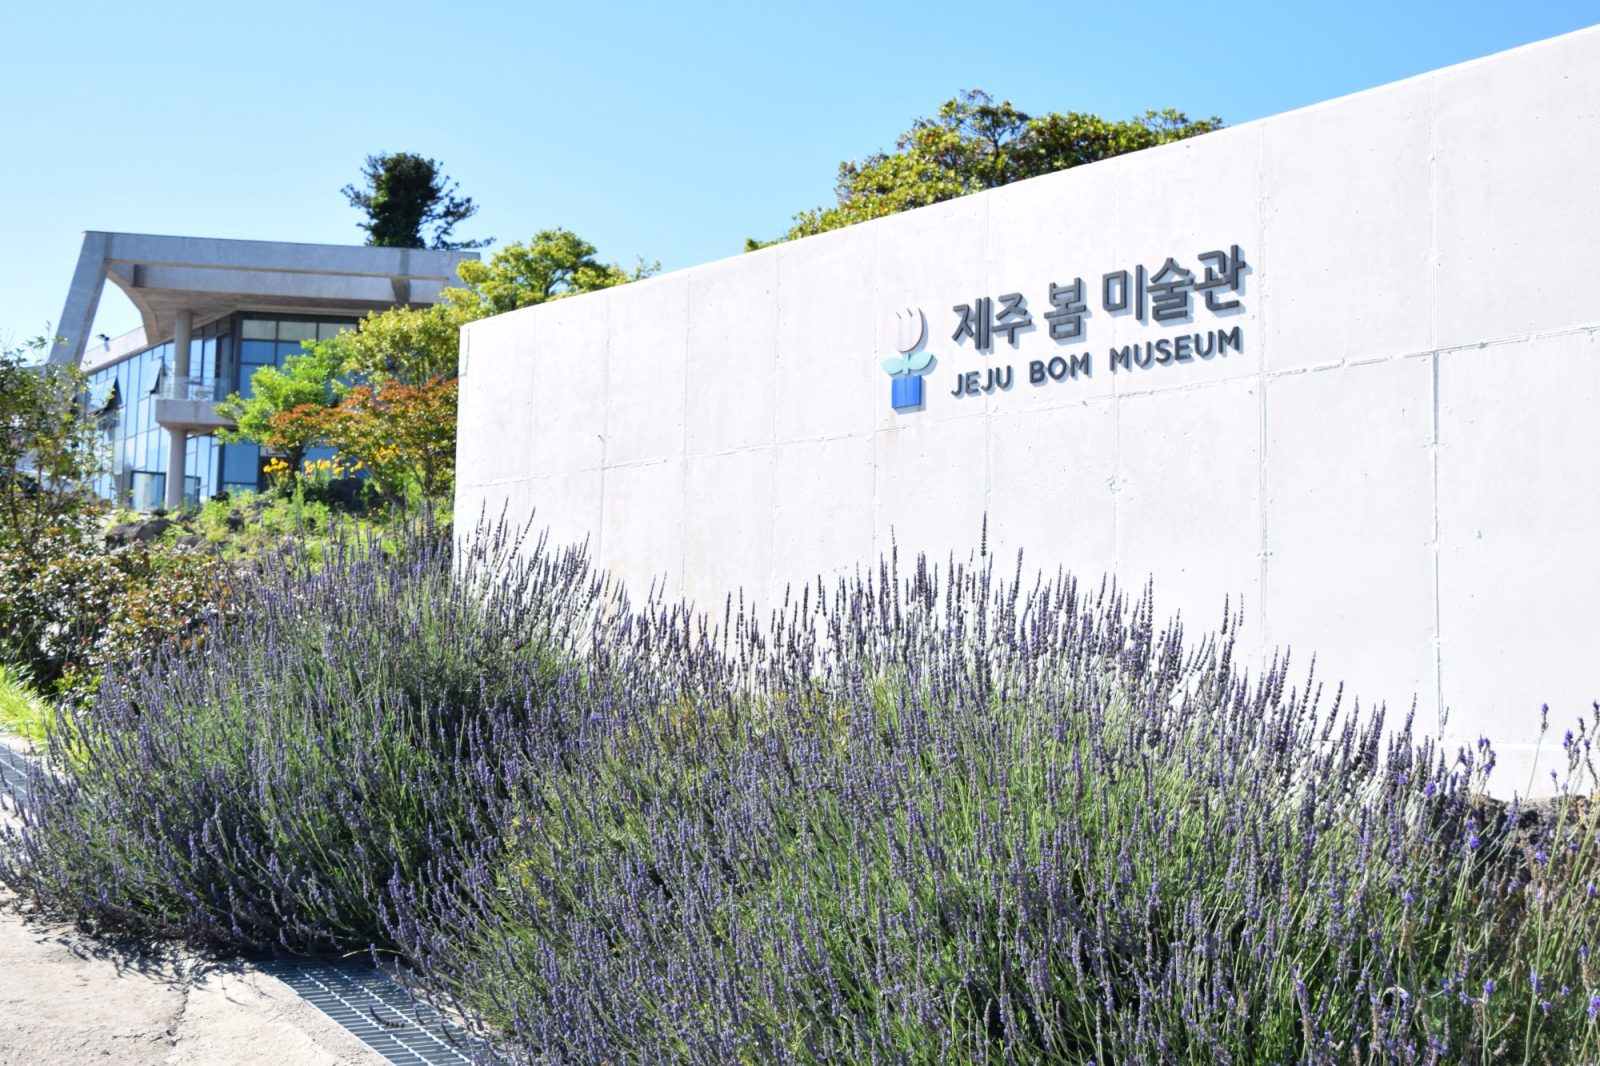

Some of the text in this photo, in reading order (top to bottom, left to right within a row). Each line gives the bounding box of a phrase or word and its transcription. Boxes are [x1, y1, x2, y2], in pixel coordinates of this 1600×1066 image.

[951, 244, 1247, 351] 제주 봄 미술관
[950, 326, 1242, 398] JEJU BOM MUSEUM
